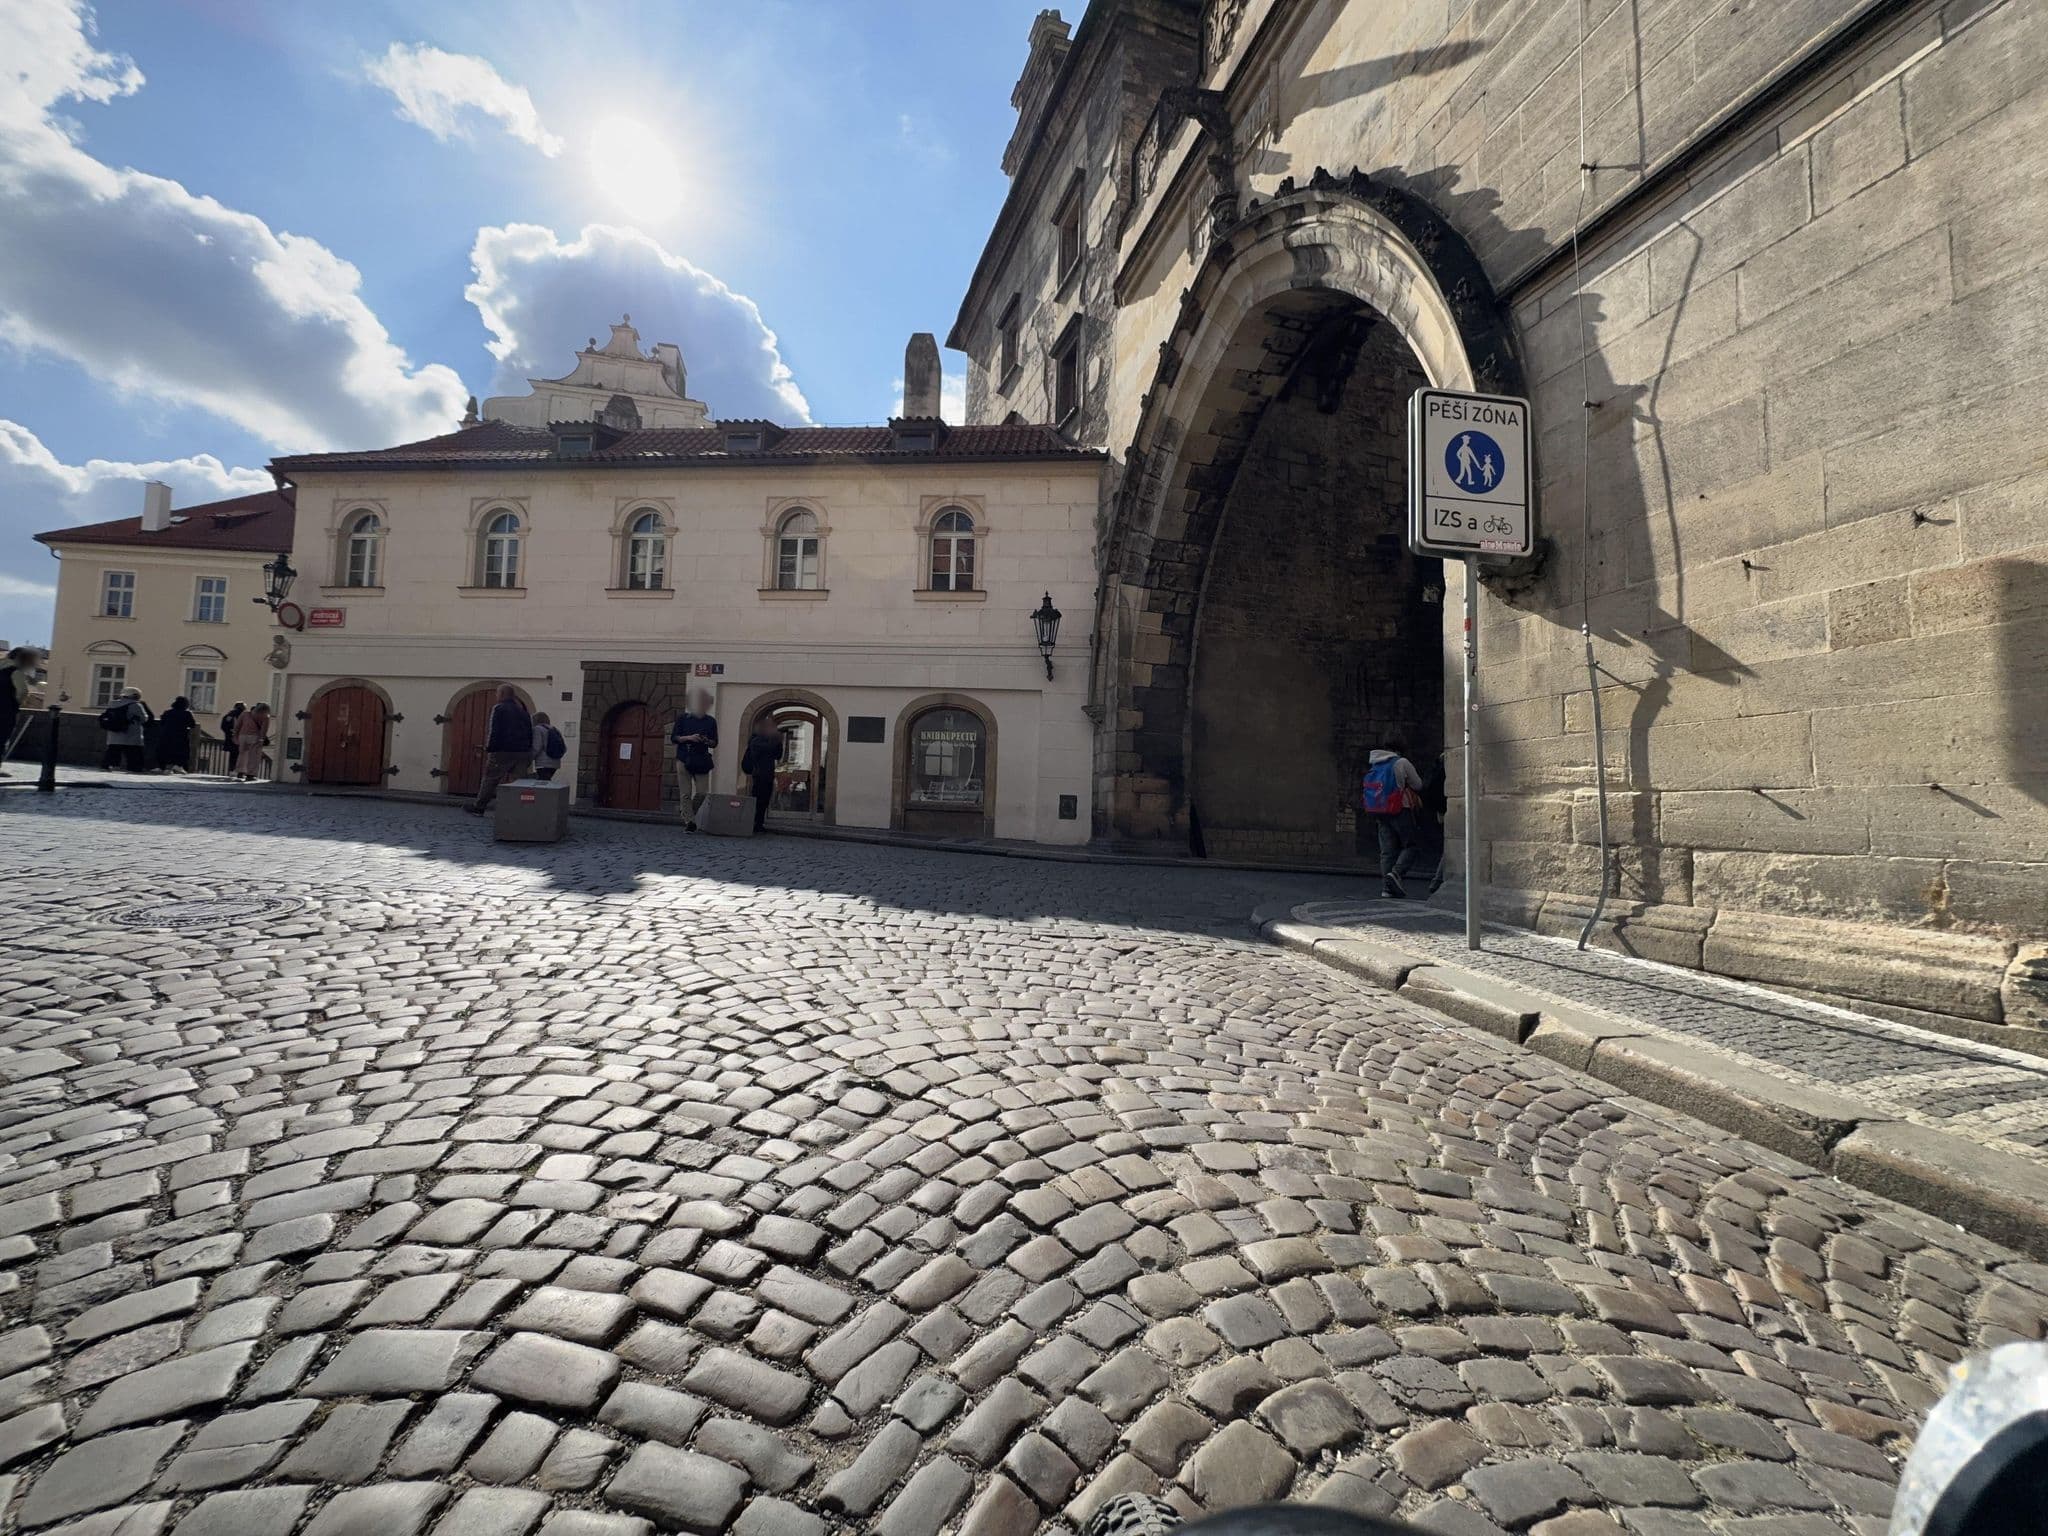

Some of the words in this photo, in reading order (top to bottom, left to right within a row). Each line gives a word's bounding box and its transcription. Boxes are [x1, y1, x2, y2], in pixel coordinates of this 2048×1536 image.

[1430, 400, 1467, 420] PĚŠÍ
[1472, 405, 1518, 426] ZÓNA
[1434, 509, 1462, 528] IZS
[1467, 517, 1477, 530] a
